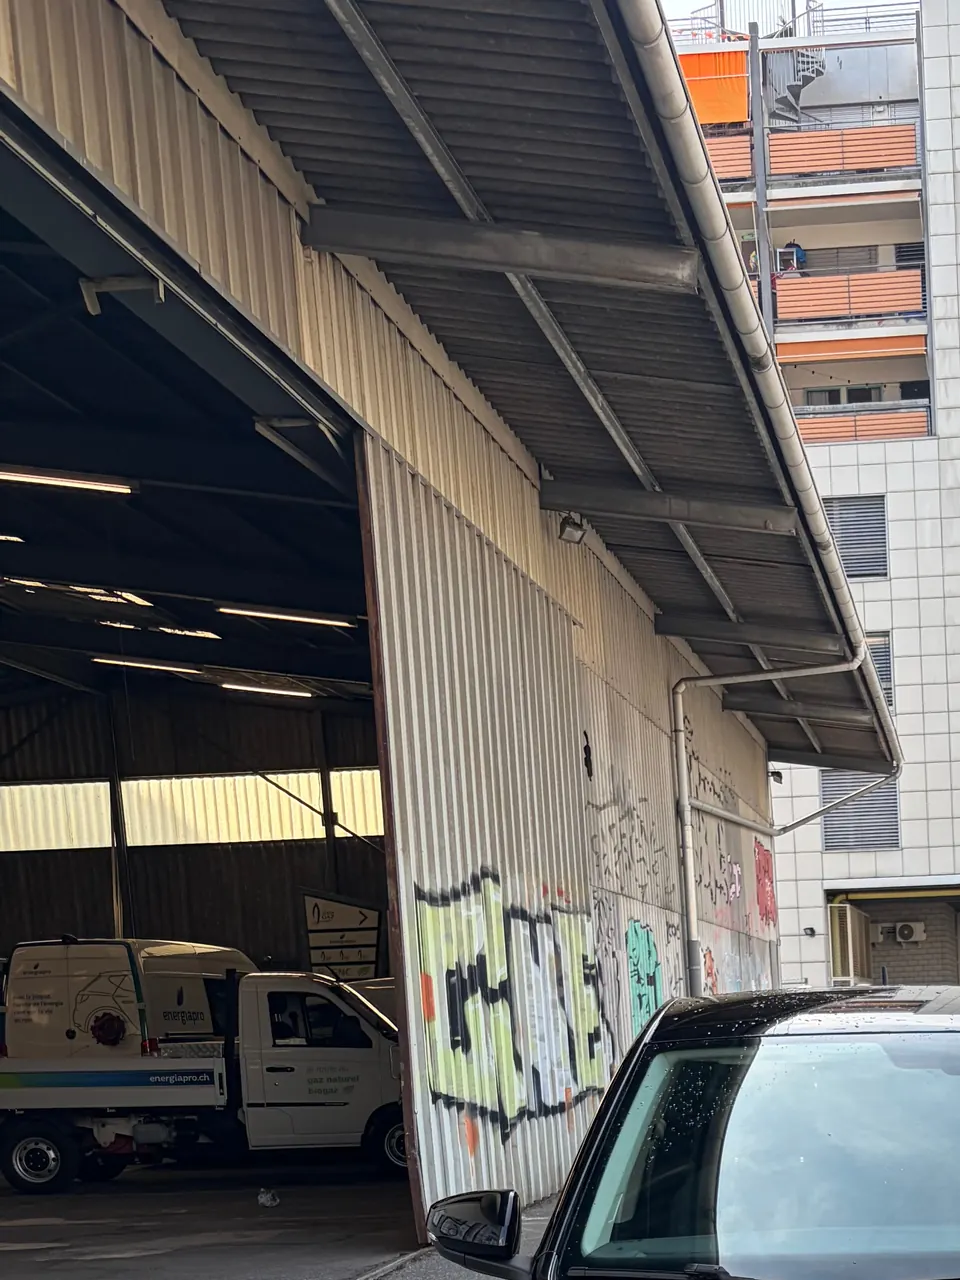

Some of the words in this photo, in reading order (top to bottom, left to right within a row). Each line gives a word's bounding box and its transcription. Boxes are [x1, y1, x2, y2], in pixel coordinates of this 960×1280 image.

[162, 1010, 205, 1025] energiapro
[149, 1073, 210, 1084] energiapro.ch
[326, 1075, 360, 1084] naturel
[308, 1086, 338, 1096] biogaz
